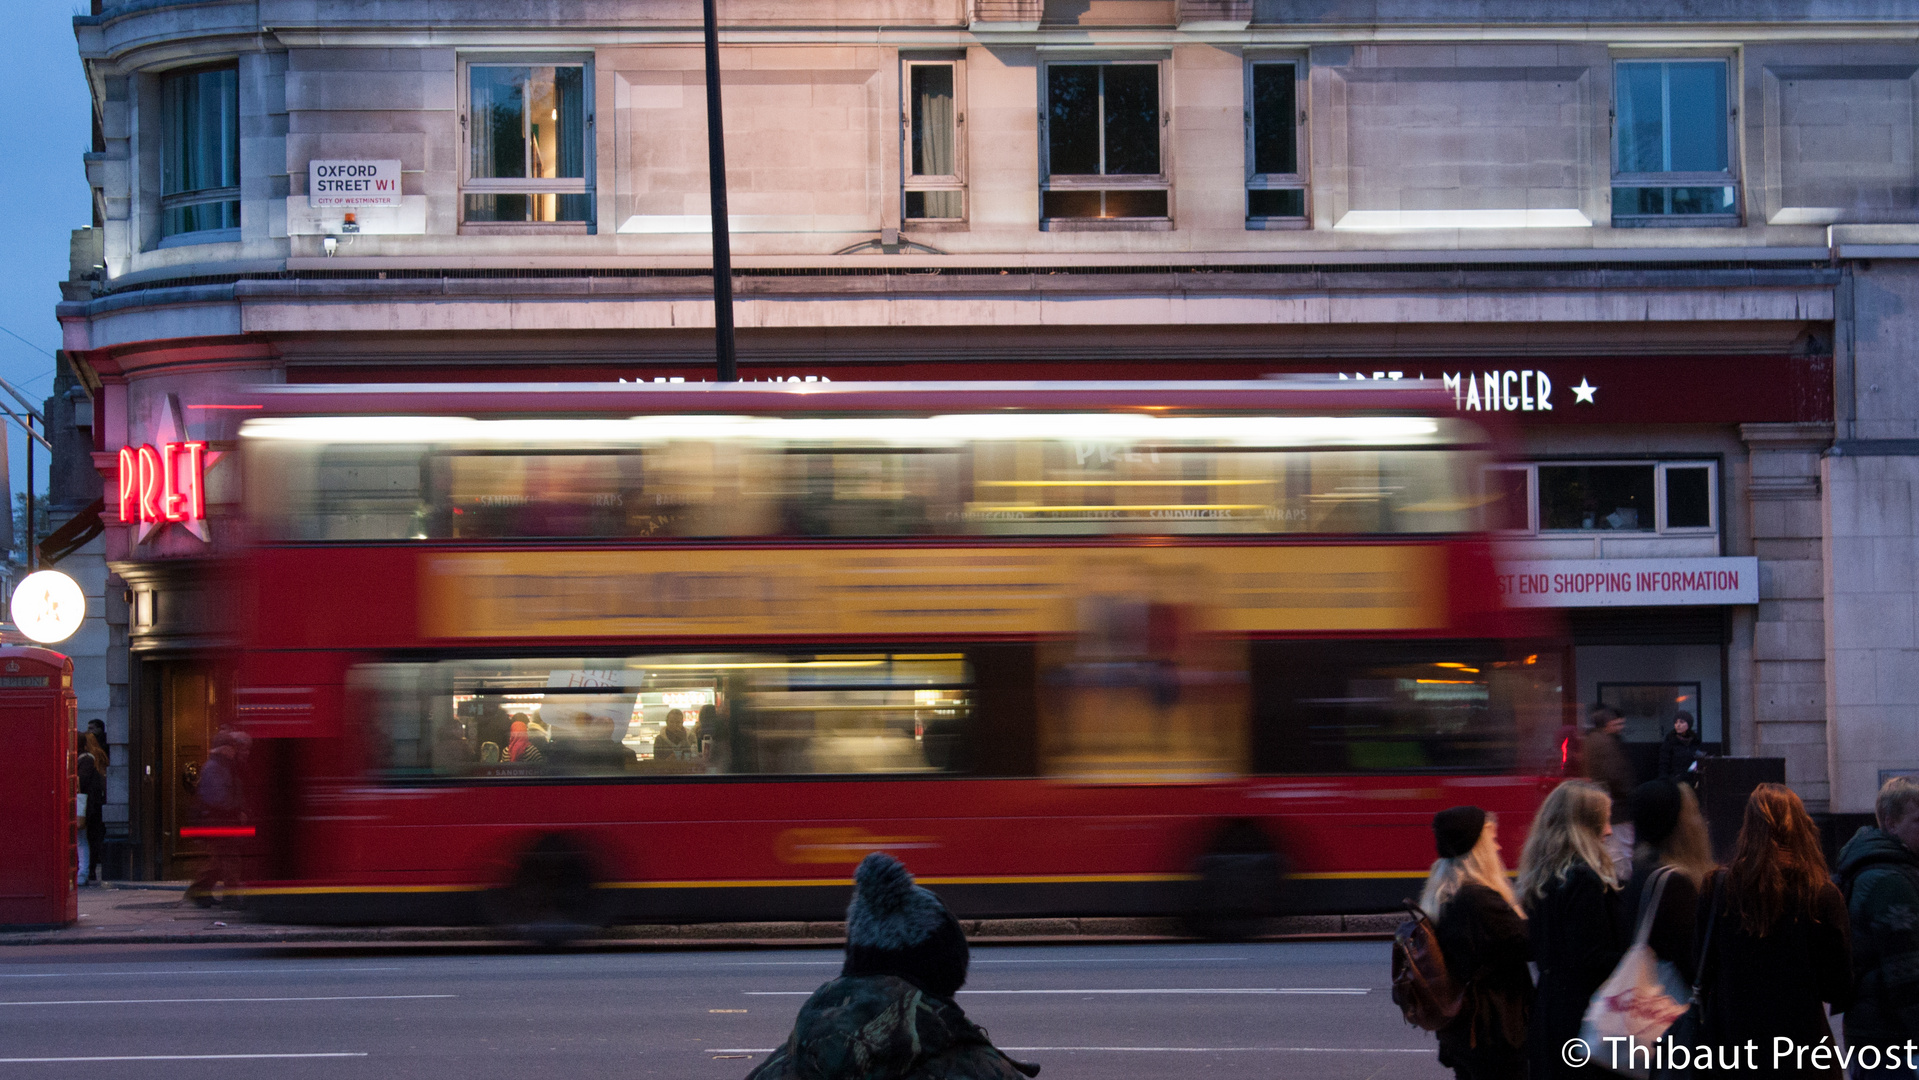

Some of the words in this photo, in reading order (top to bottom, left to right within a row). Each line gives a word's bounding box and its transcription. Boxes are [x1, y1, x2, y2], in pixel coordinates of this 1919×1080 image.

[317, 165, 377, 177] OXFORD
[317, 180, 371, 191] STREET
[375, 179, 395, 191] W1
[1442, 370, 1553, 411] MANGER
[119, 441, 209, 524] PRET
[1264, 508, 1308, 521] WRAPS
[1496, 573, 1515, 595] ST
[1519, 573, 1549, 594] END
[1553, 572, 1632, 593] SHOPPING
[1636, 570, 1739, 592] INFORMATION
